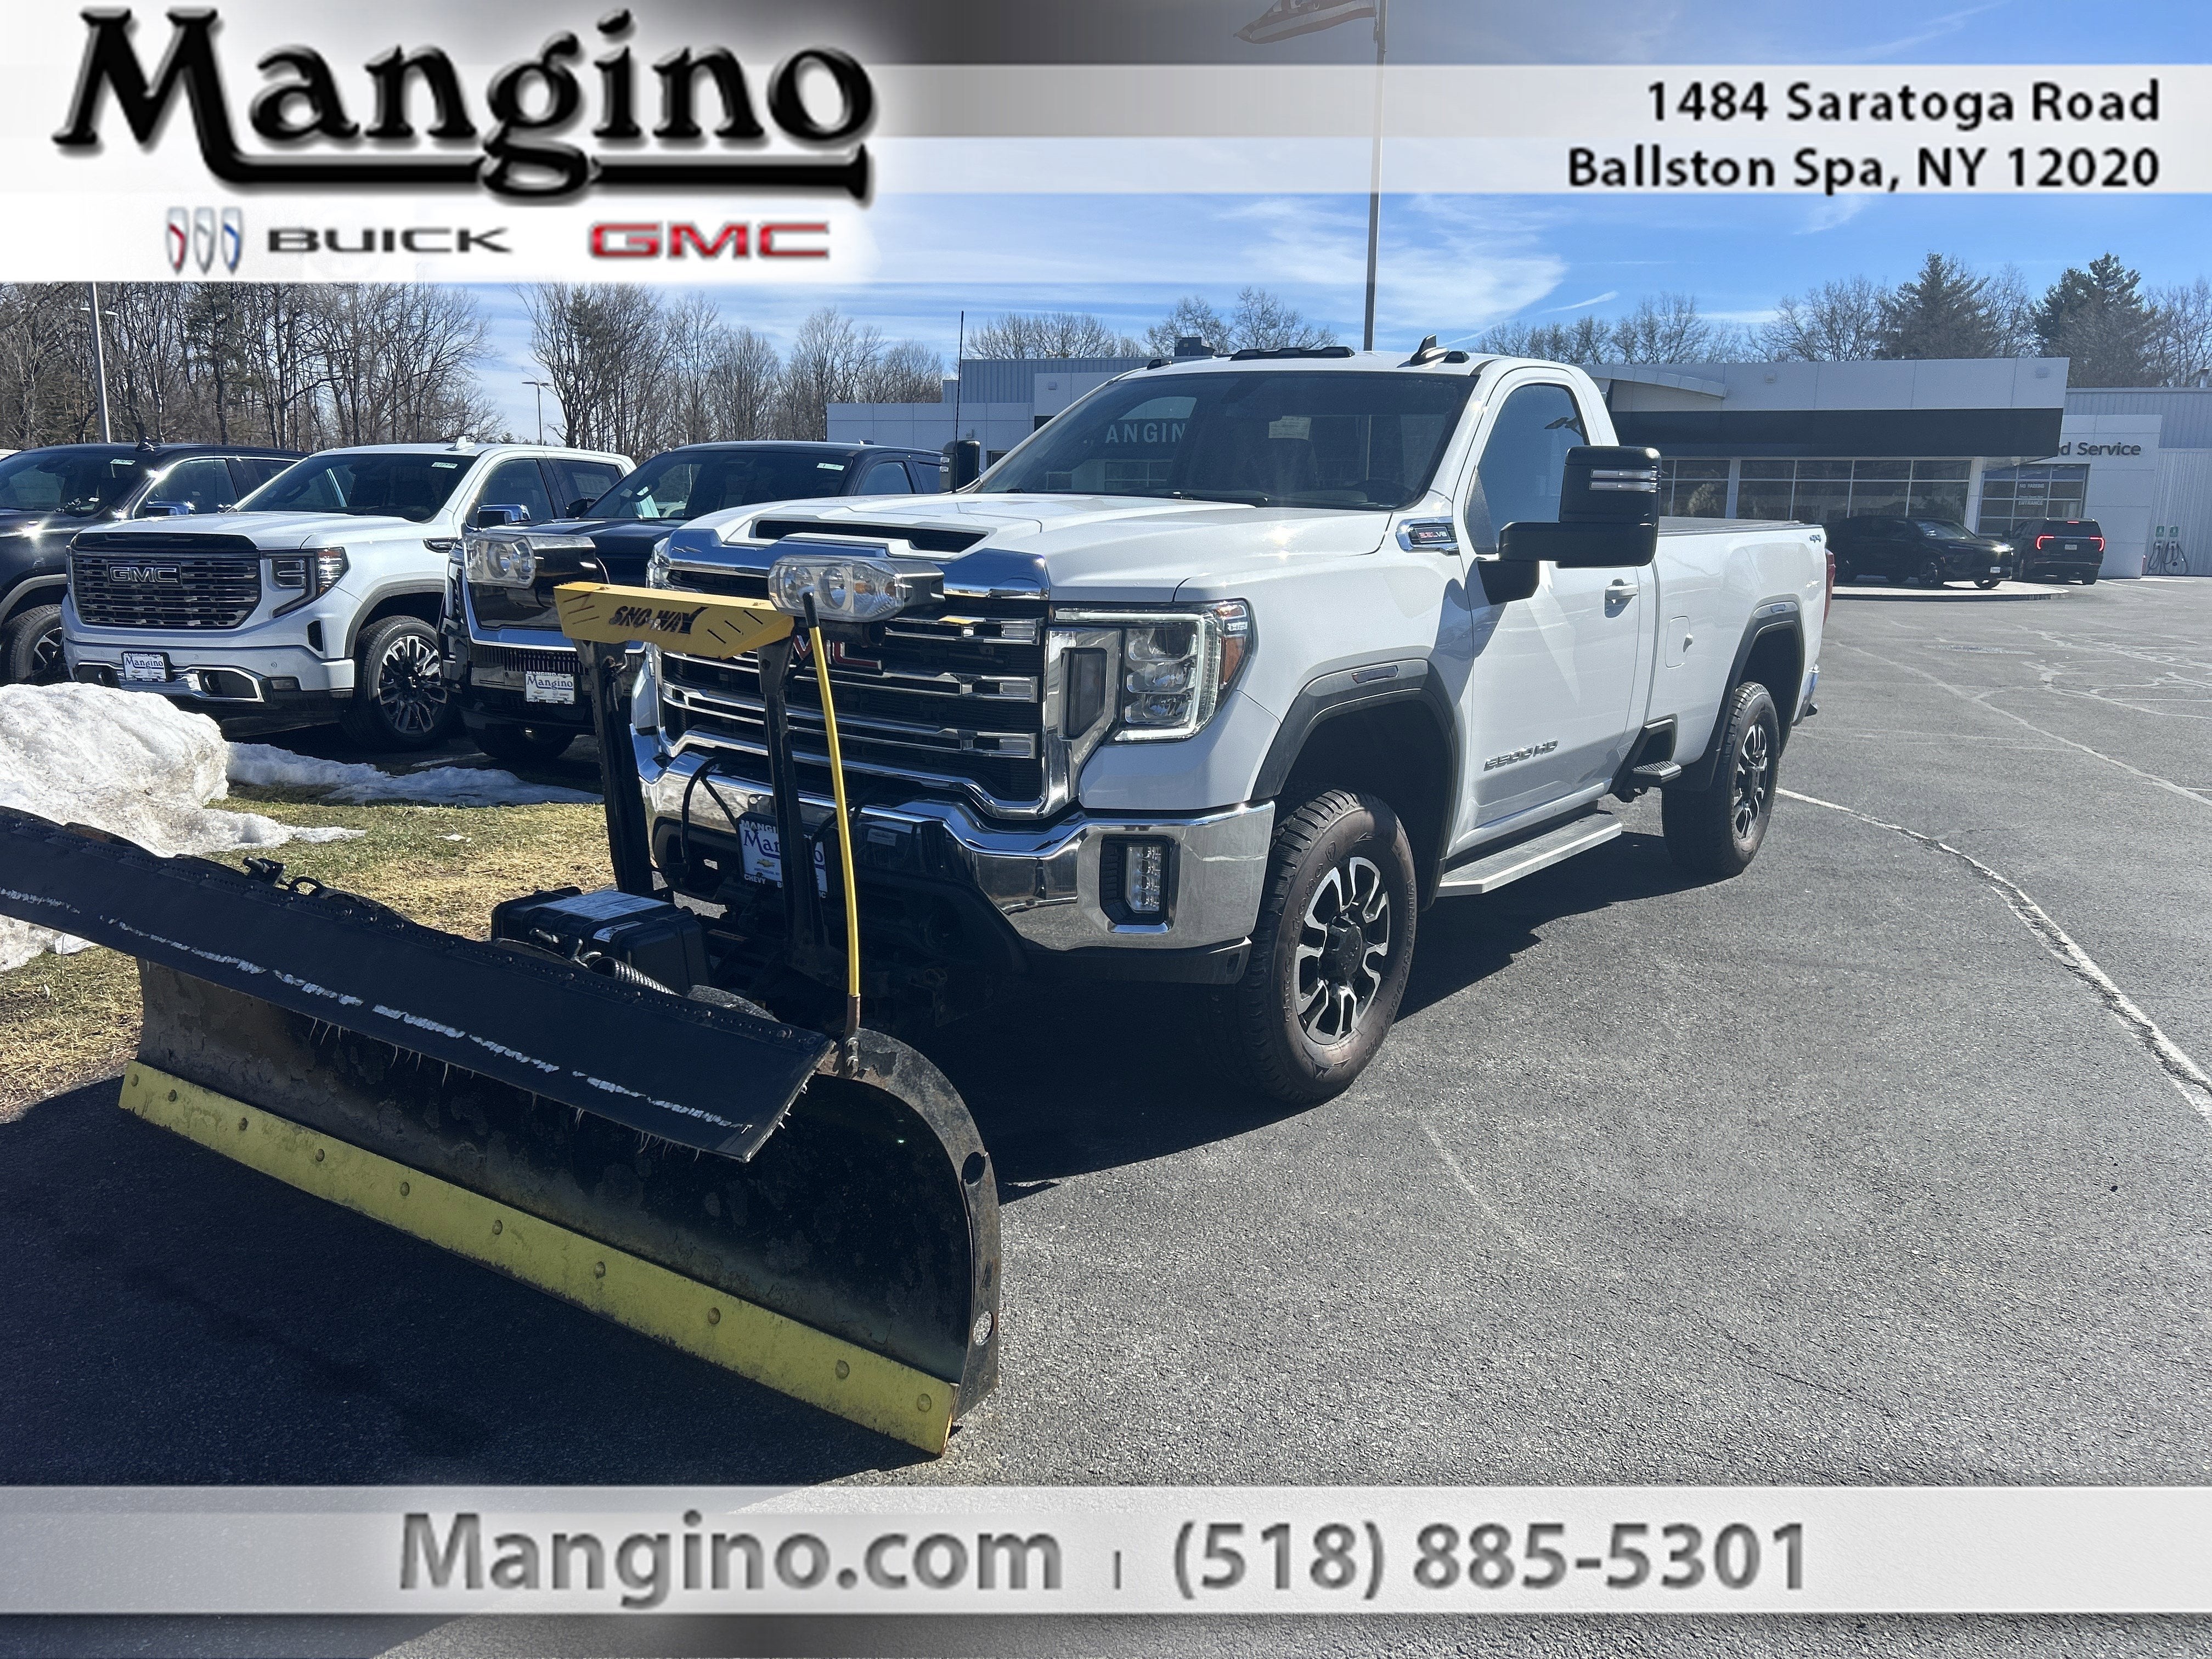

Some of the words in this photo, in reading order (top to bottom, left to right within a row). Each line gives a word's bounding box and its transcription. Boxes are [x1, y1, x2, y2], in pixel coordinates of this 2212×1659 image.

[2077, 442, 2141, 456] Service
[111, 567, 178, 583] GMC
[609, 606, 708, 634] SNO-WAY
[125, 657, 164, 669] Mangino
[527, 676, 573, 690] Mangino
